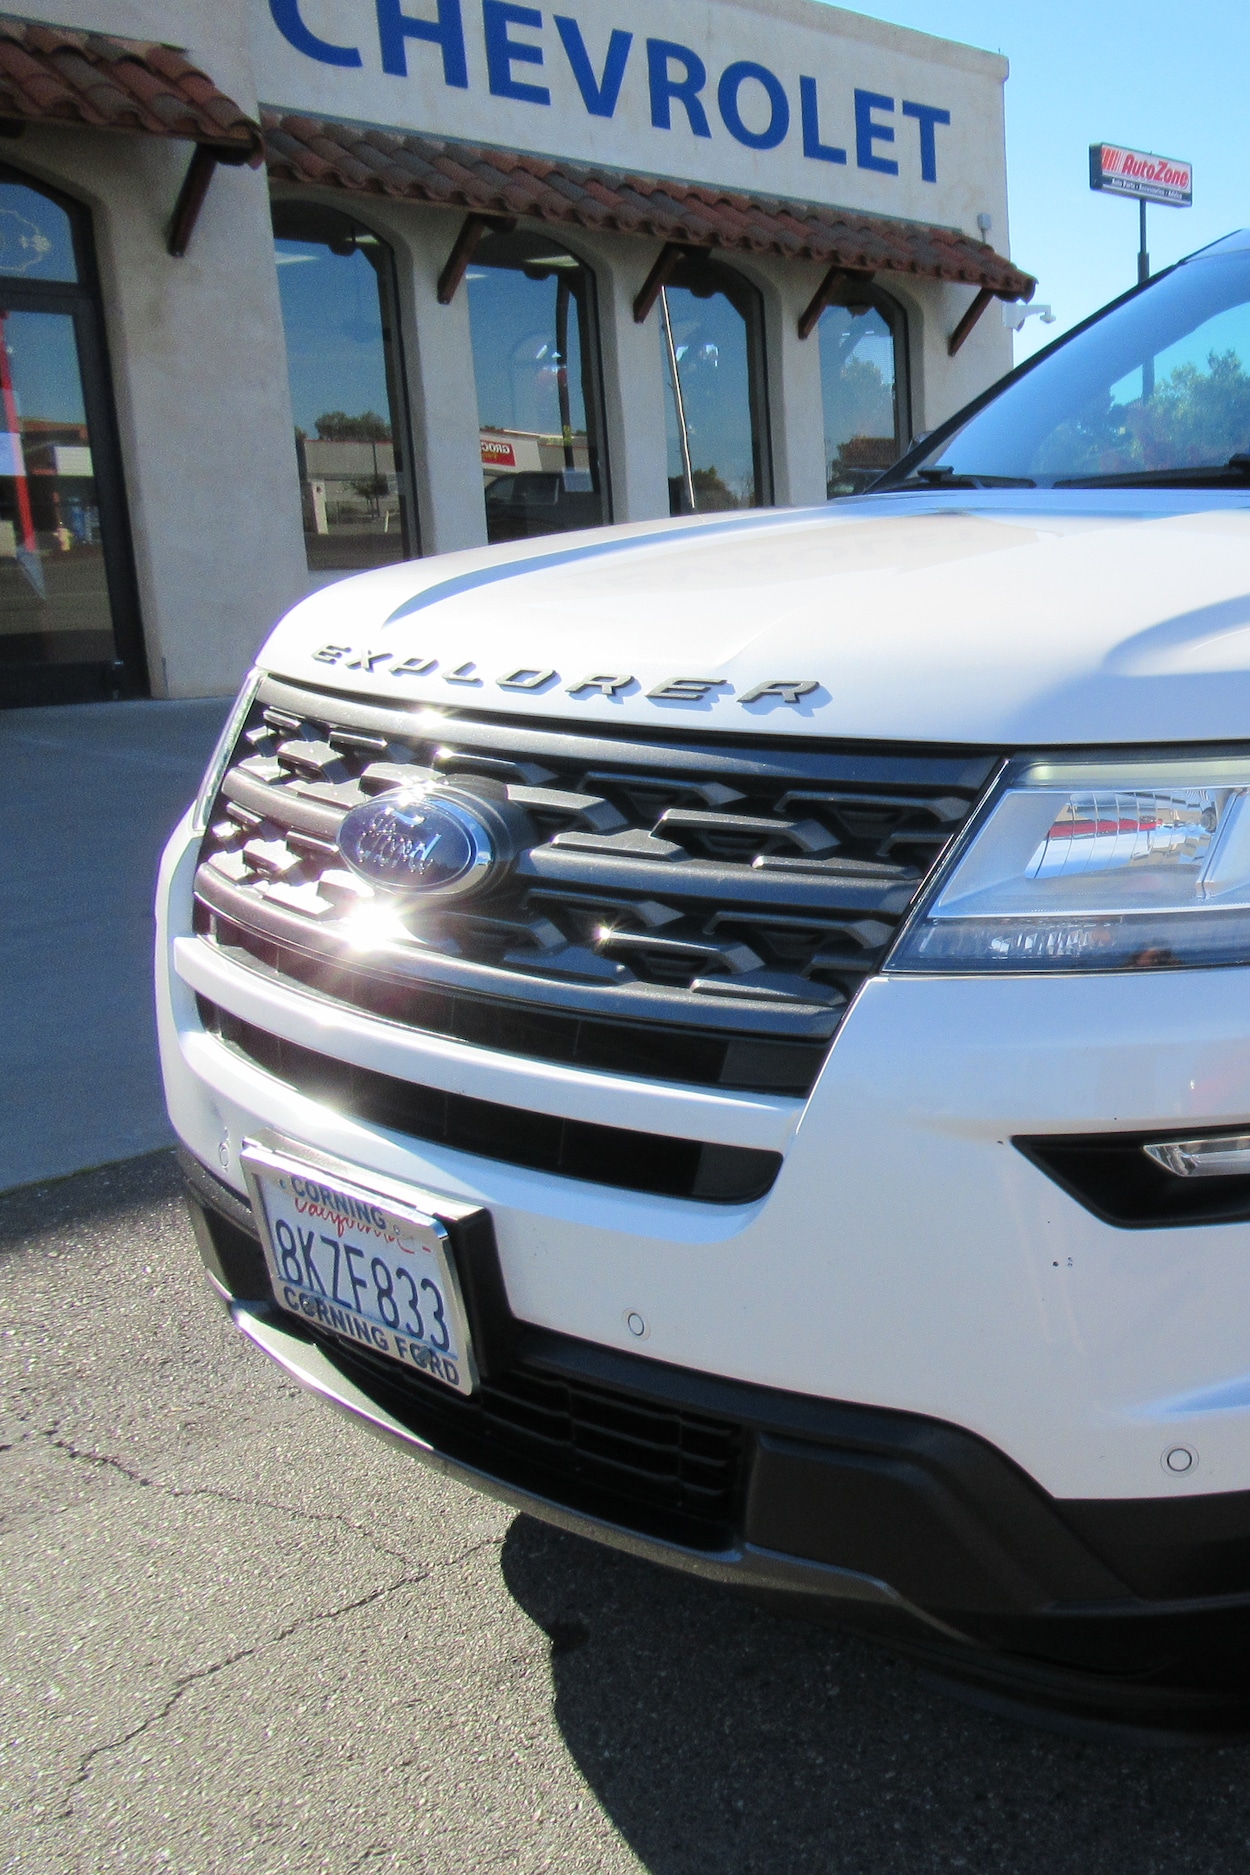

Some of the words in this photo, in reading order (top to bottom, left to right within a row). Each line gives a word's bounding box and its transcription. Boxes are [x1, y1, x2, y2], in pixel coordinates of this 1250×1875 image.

[269, 0, 950, 183] CHEVROLET
[1122, 154, 1188, 187] AutoZone
[310, 643, 823, 704] EXPLORER
[290, 1175, 387, 1230] CORNING
[275, 1218, 451, 1352] 8KZF833
[283, 1286, 390, 1351] CORNING
[394, 1335, 460, 1386] FORD
